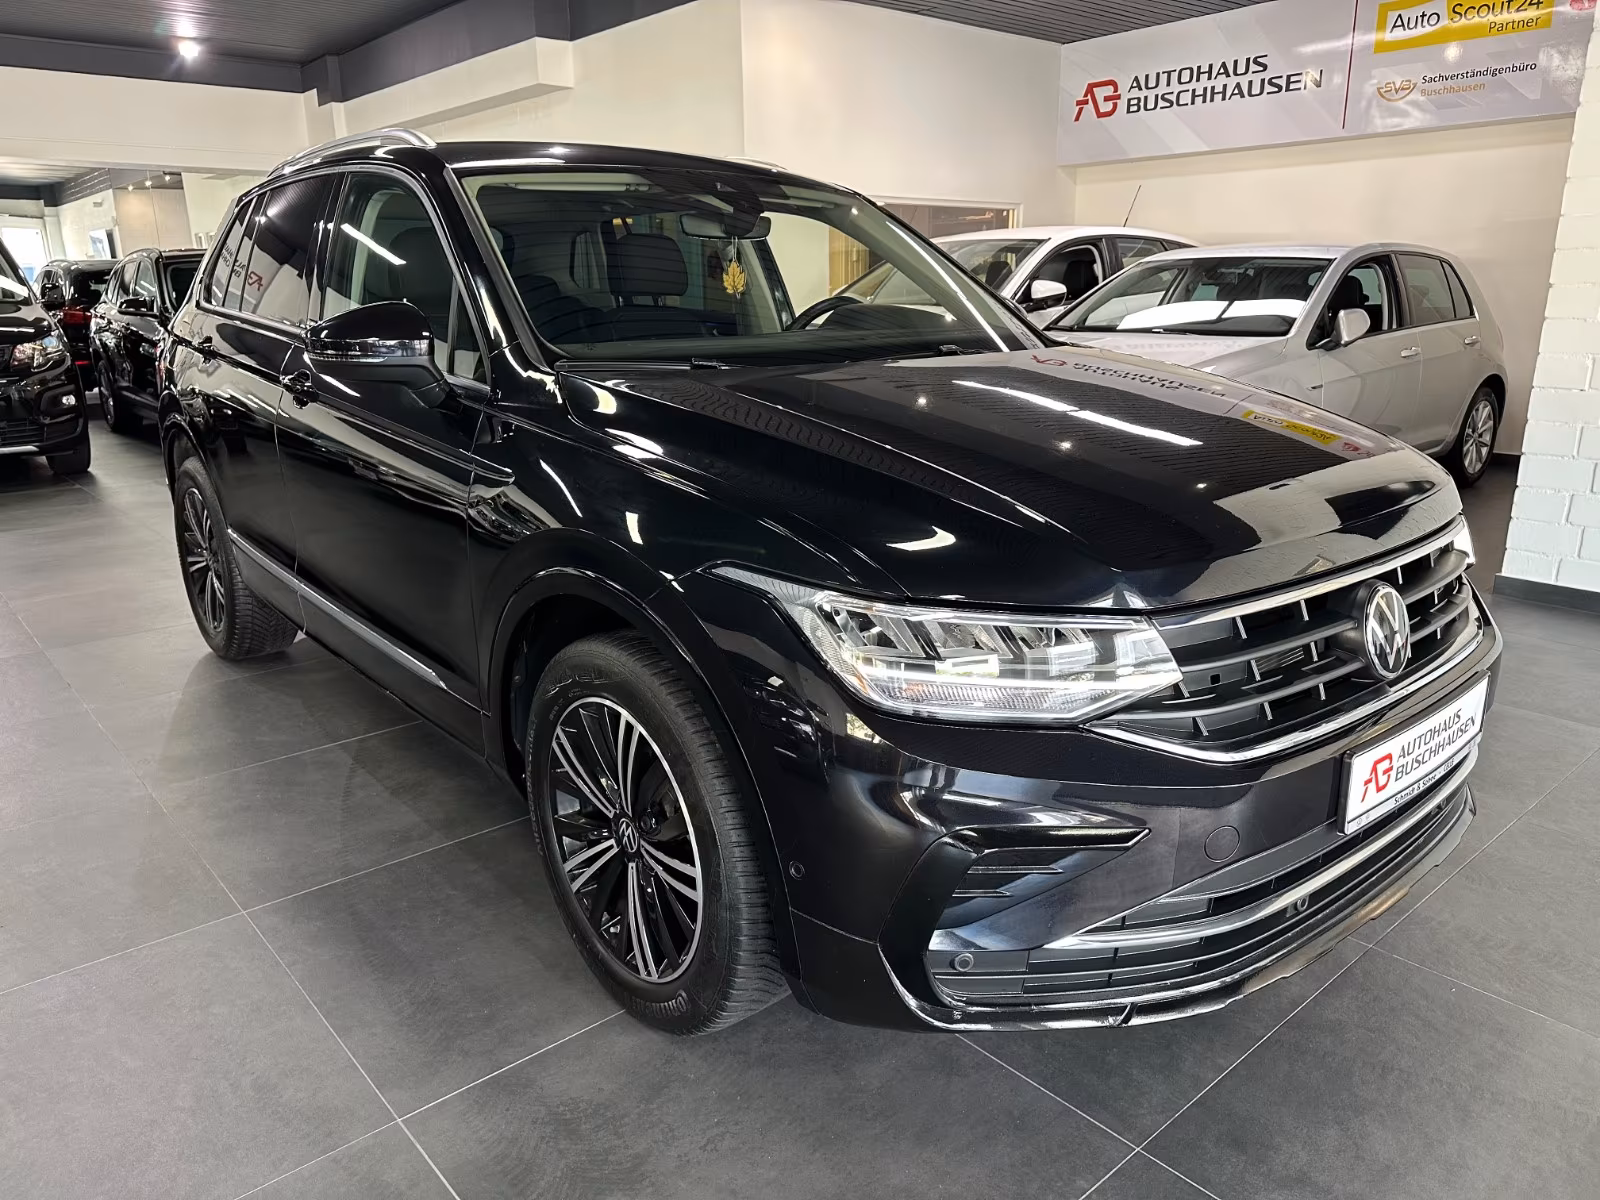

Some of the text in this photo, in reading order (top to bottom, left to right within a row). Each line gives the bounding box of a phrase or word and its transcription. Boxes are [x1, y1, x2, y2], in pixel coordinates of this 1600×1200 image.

[1389, 0, 1544, 34] Auto Scout24
[1488, 14, 1542, 34] Partner
[1127, 54, 1269, 94] AUTOHAUS
[1419, 82, 1486, 97] Buschhausen
[1421, 61, 1538, 84] Sachverständigenbüro
[1126, 69, 1324, 114] BUSCHHAUSEN
[1394, 712, 1477, 782] BUSCHHAUSEN
[1397, 708, 1463, 763] AUTOHAUS
